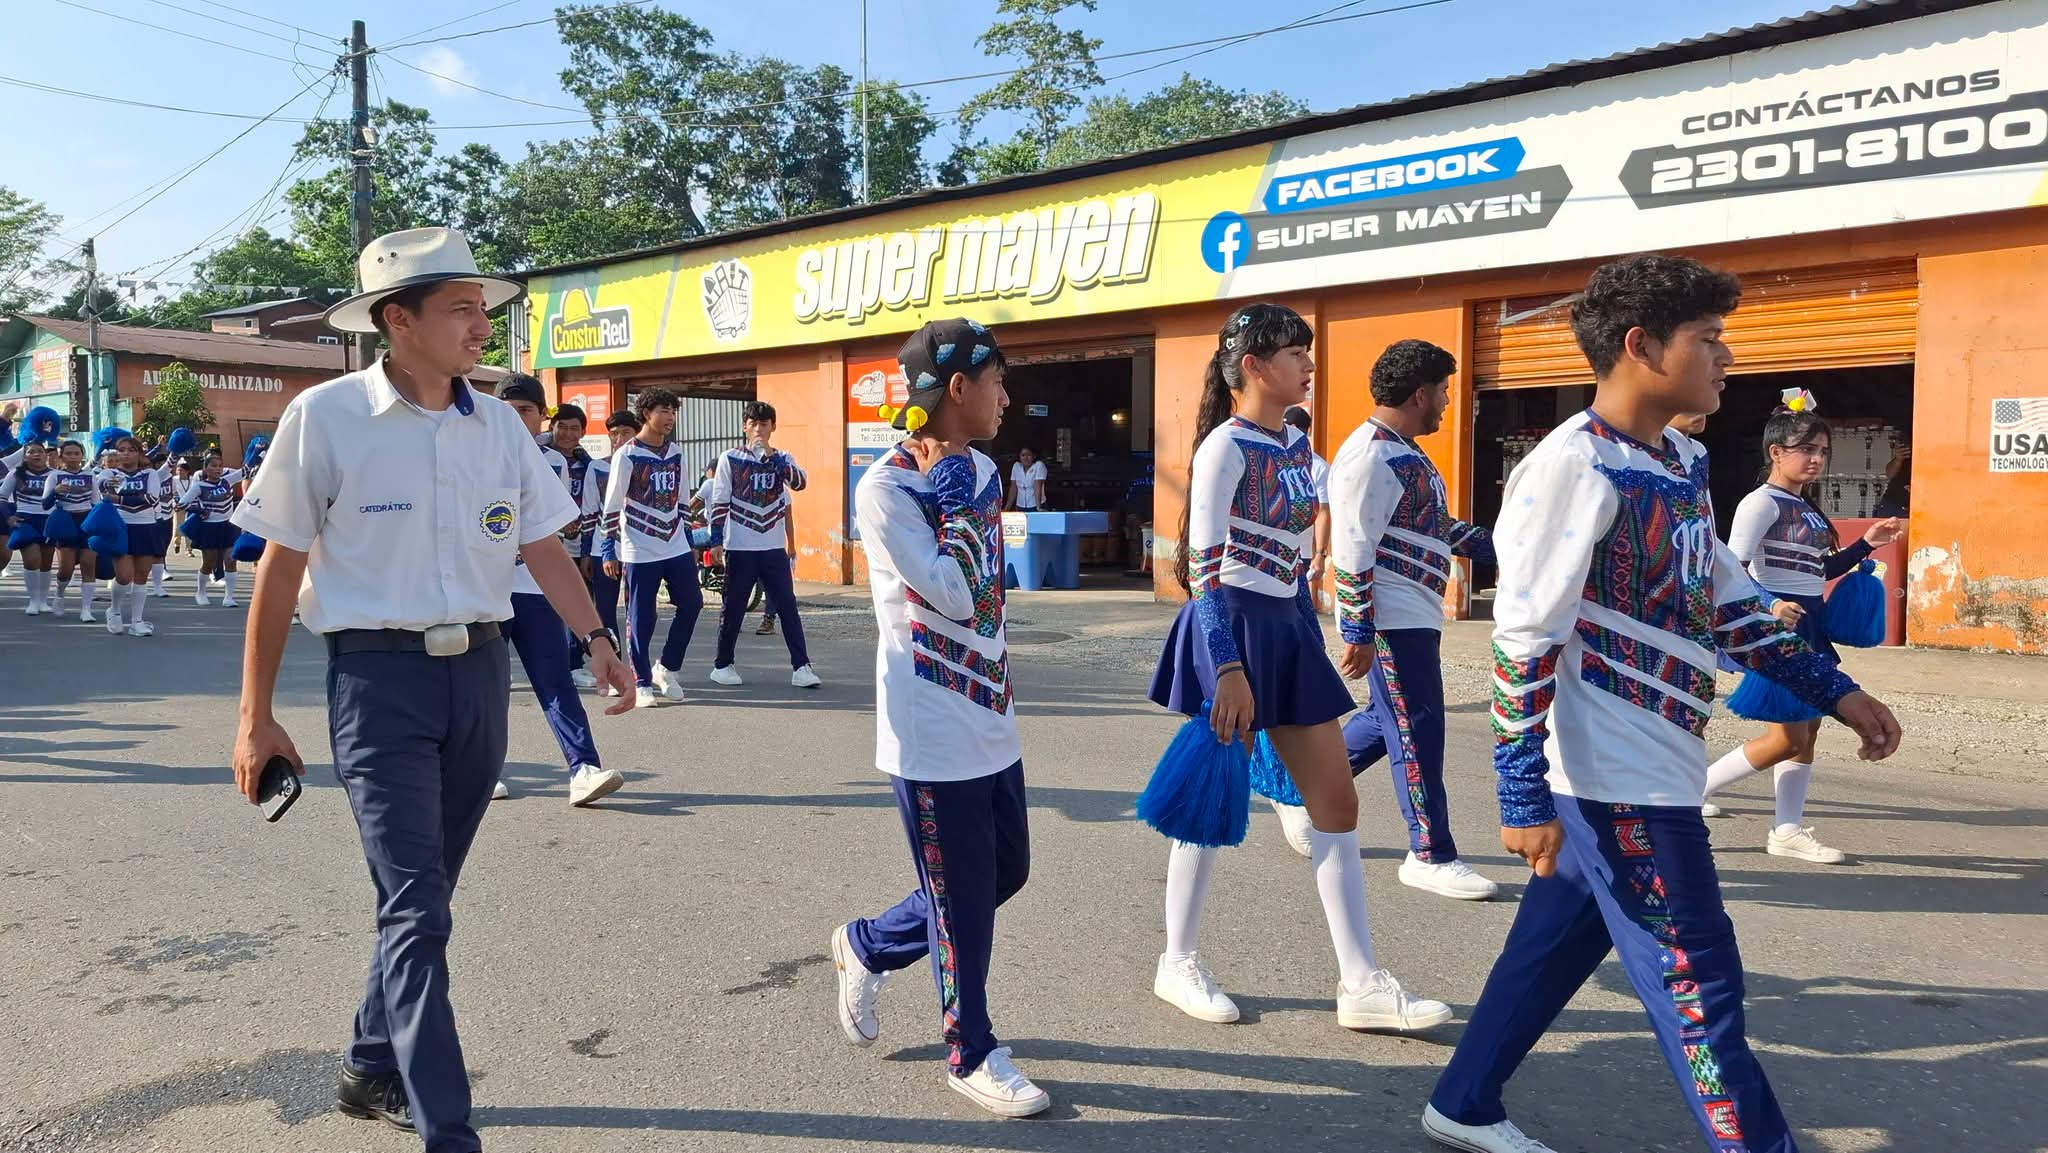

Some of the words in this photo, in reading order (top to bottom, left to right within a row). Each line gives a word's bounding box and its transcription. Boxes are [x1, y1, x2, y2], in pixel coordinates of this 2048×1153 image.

[1681, 69, 2000, 136] CONTÁCTANOS
[1277, 147, 1501, 206] FACEBOOK
[1650, 107, 2047, 195] 2301-8100
[1256, 214, 1380, 251] SUPER
[1395, 191, 1543, 233] MAYEN
[793, 226, 945, 323] super
[943, 191, 1160, 304] mayen
[553, 315, 628, 352] ConstruRed
[70, 354, 78, 432] OLARIZADO
[1993, 433, 2048, 456] USA
[359, 501, 413, 514] CATEDRÁTICO
